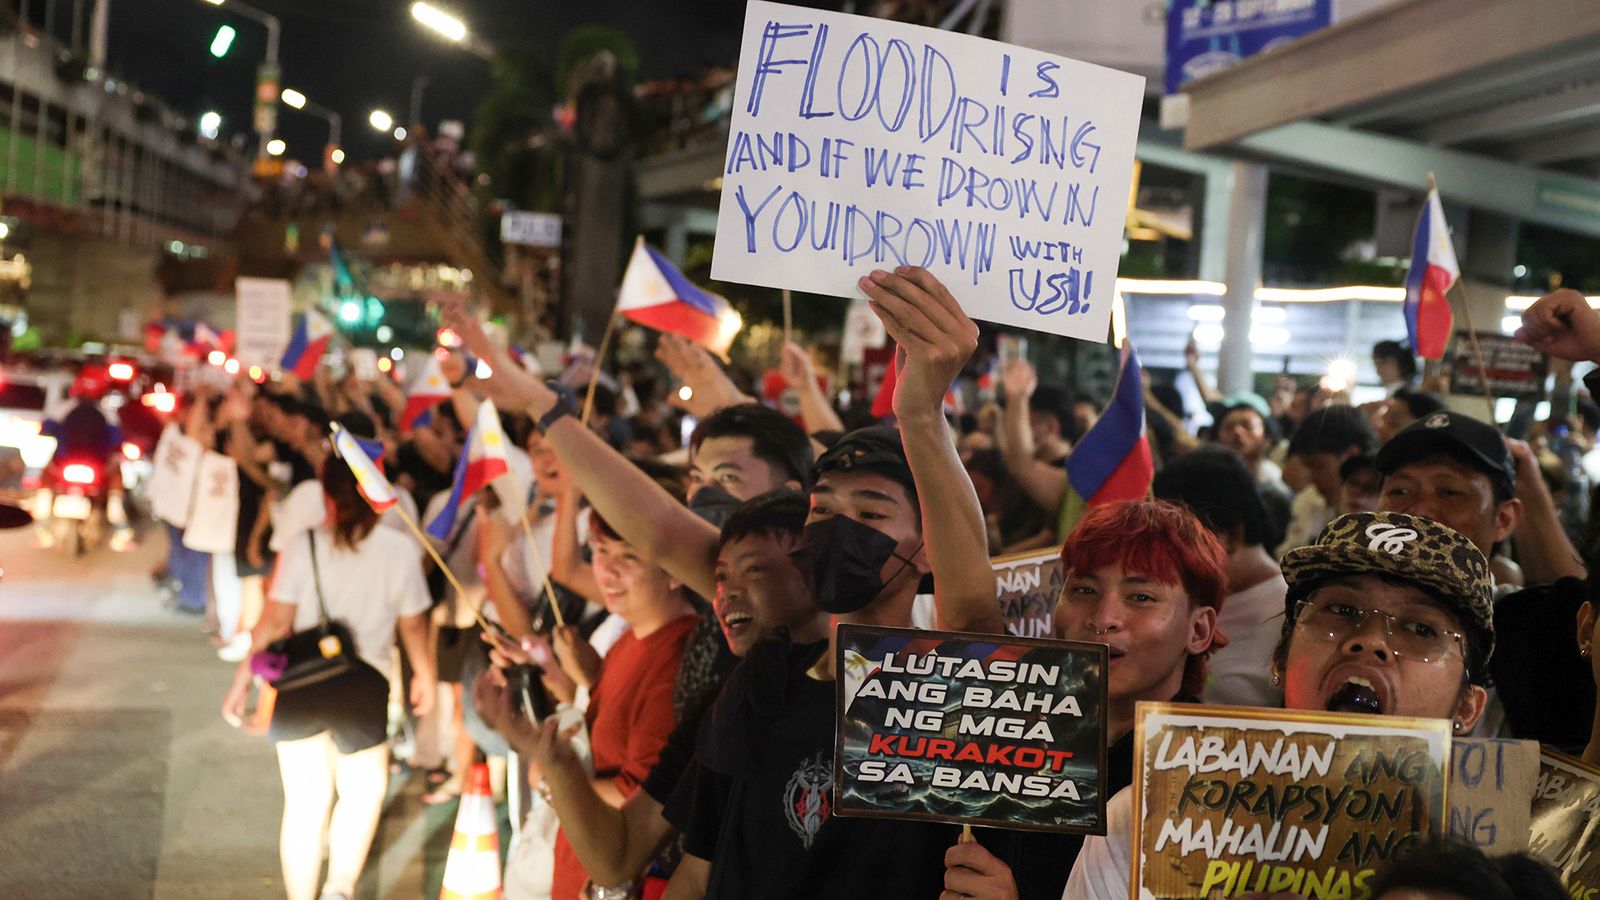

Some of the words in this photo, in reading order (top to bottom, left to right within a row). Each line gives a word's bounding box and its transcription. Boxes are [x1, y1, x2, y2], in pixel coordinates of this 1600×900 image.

[747, 21, 957, 143] FLOOD
[1000, 54, 1060, 98] IS
[727, 131, 810, 175] AND
[820, 137, 855, 179] IF
[864, 147, 926, 190] WE
[937, 157, 1099, 227] DROWN
[843, 204, 996, 285] DROWN
[1009, 235, 1083, 264] WITH
[882, 652, 1060, 686] LUTASIN
[857, 679, 947, 704] ANG
[962, 686, 1082, 717] BAHA
[884, 707, 944, 731] NG
[959, 714, 1054, 742] MGA
[869, 733, 1073, 771] KURAKOT
[1154, 731, 1336, 782] LABANAN
[1344, 748, 1427, 785] ANG
[857, 761, 914, 784] SA
[932, 766, 1081, 800] BANSA
[1177, 775, 1406, 825] KORAPSYON
[1155, 817, 1329, 862] MAHALIN
